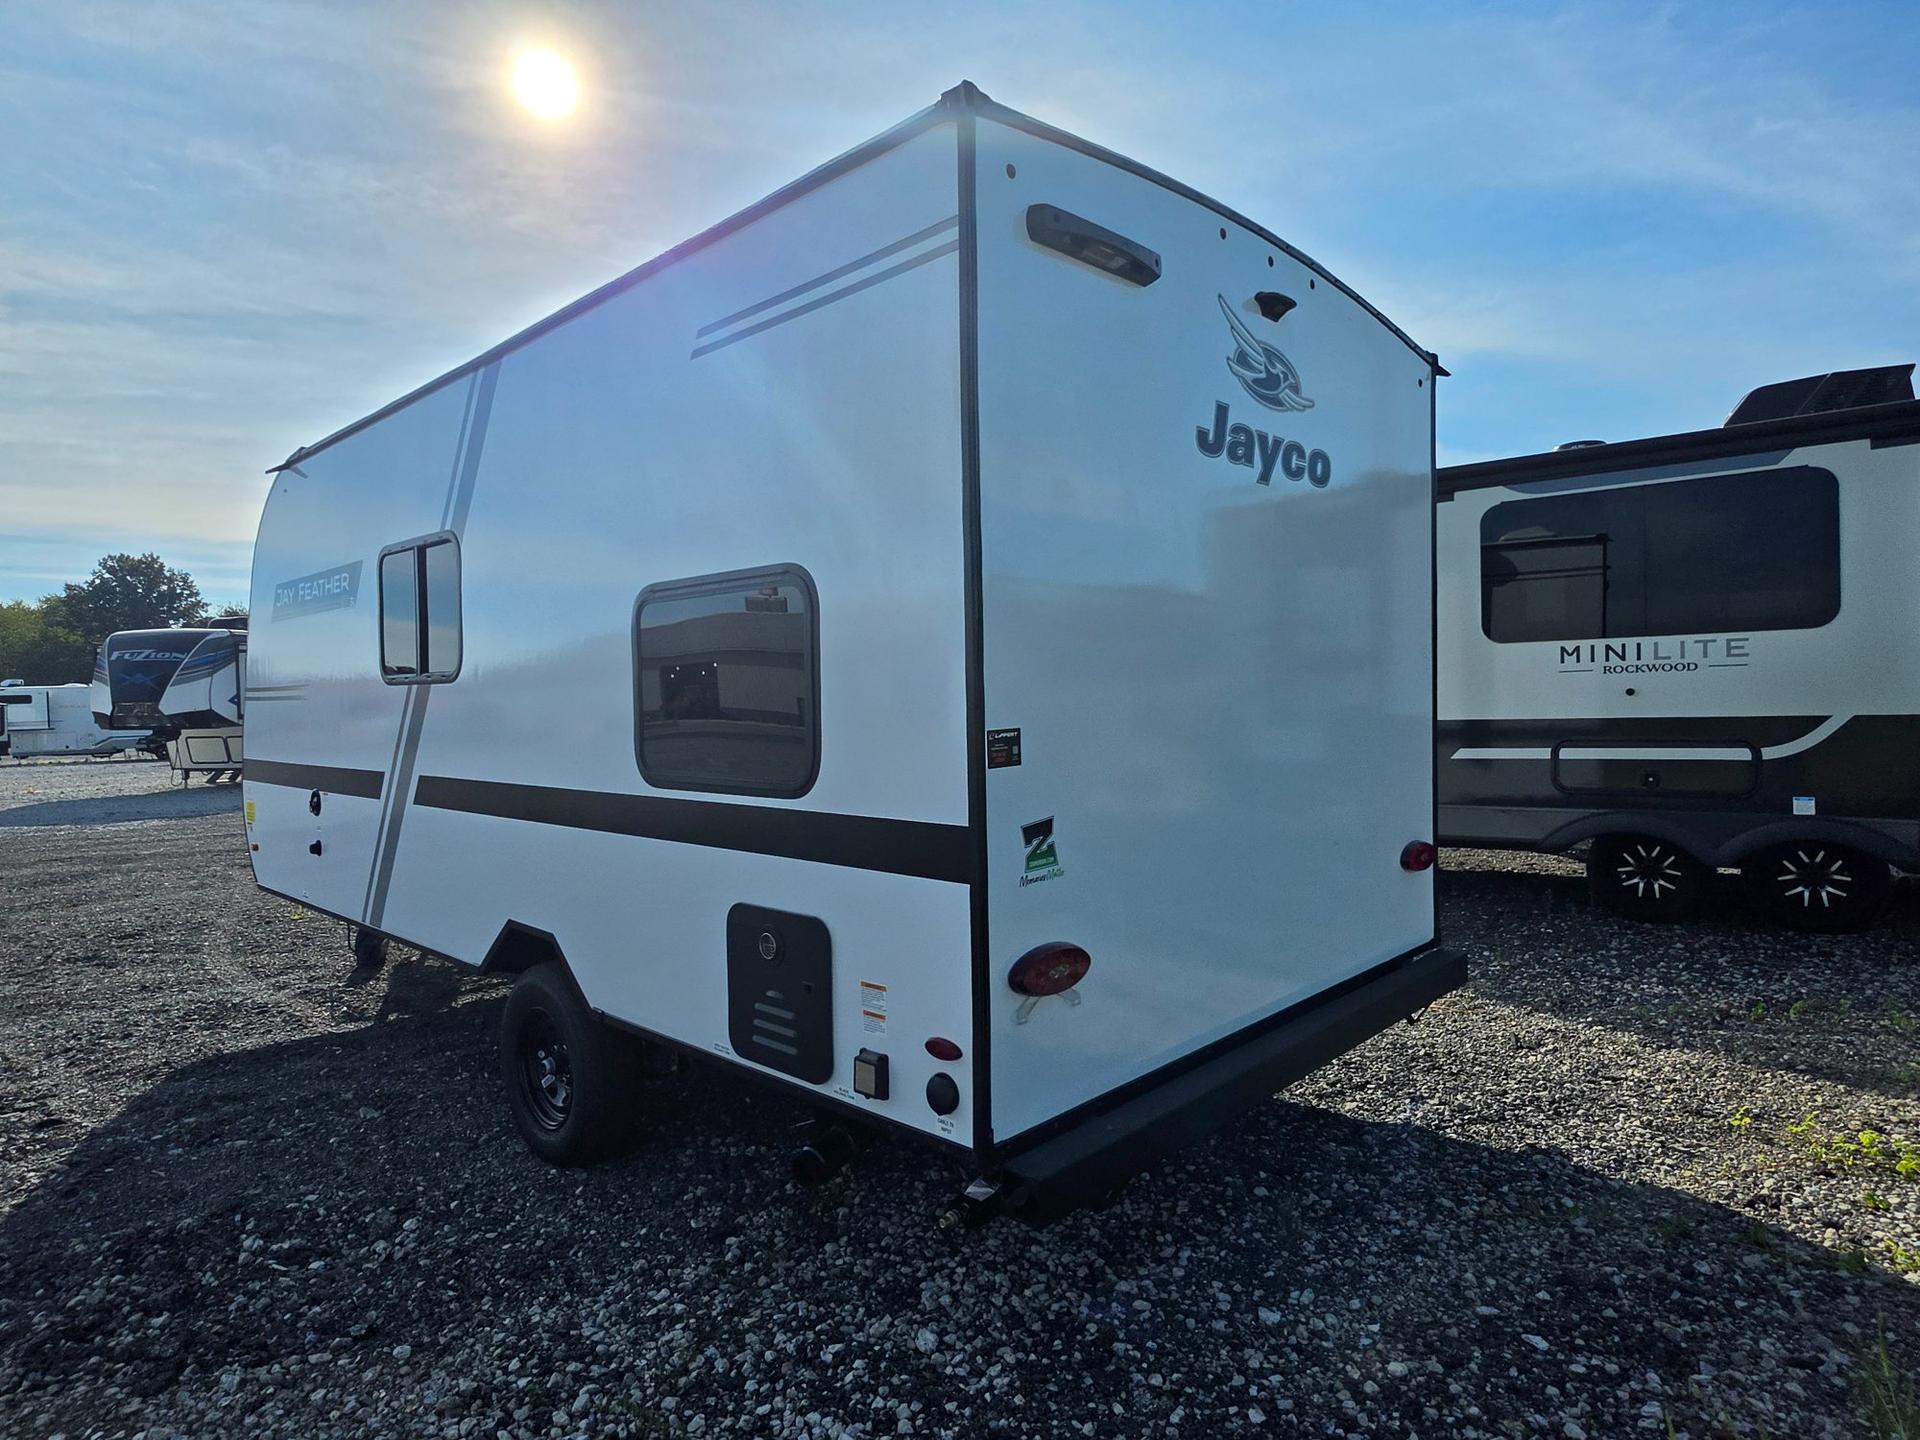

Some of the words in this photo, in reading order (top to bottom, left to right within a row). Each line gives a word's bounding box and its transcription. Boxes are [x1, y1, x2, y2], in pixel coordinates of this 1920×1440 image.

[1195, 399, 1332, 489] Jayco
[277, 586, 295, 607] JAY
[298, 573, 350, 601] FEATHER
[1603, 662, 1699, 675] ROCKWOOD
